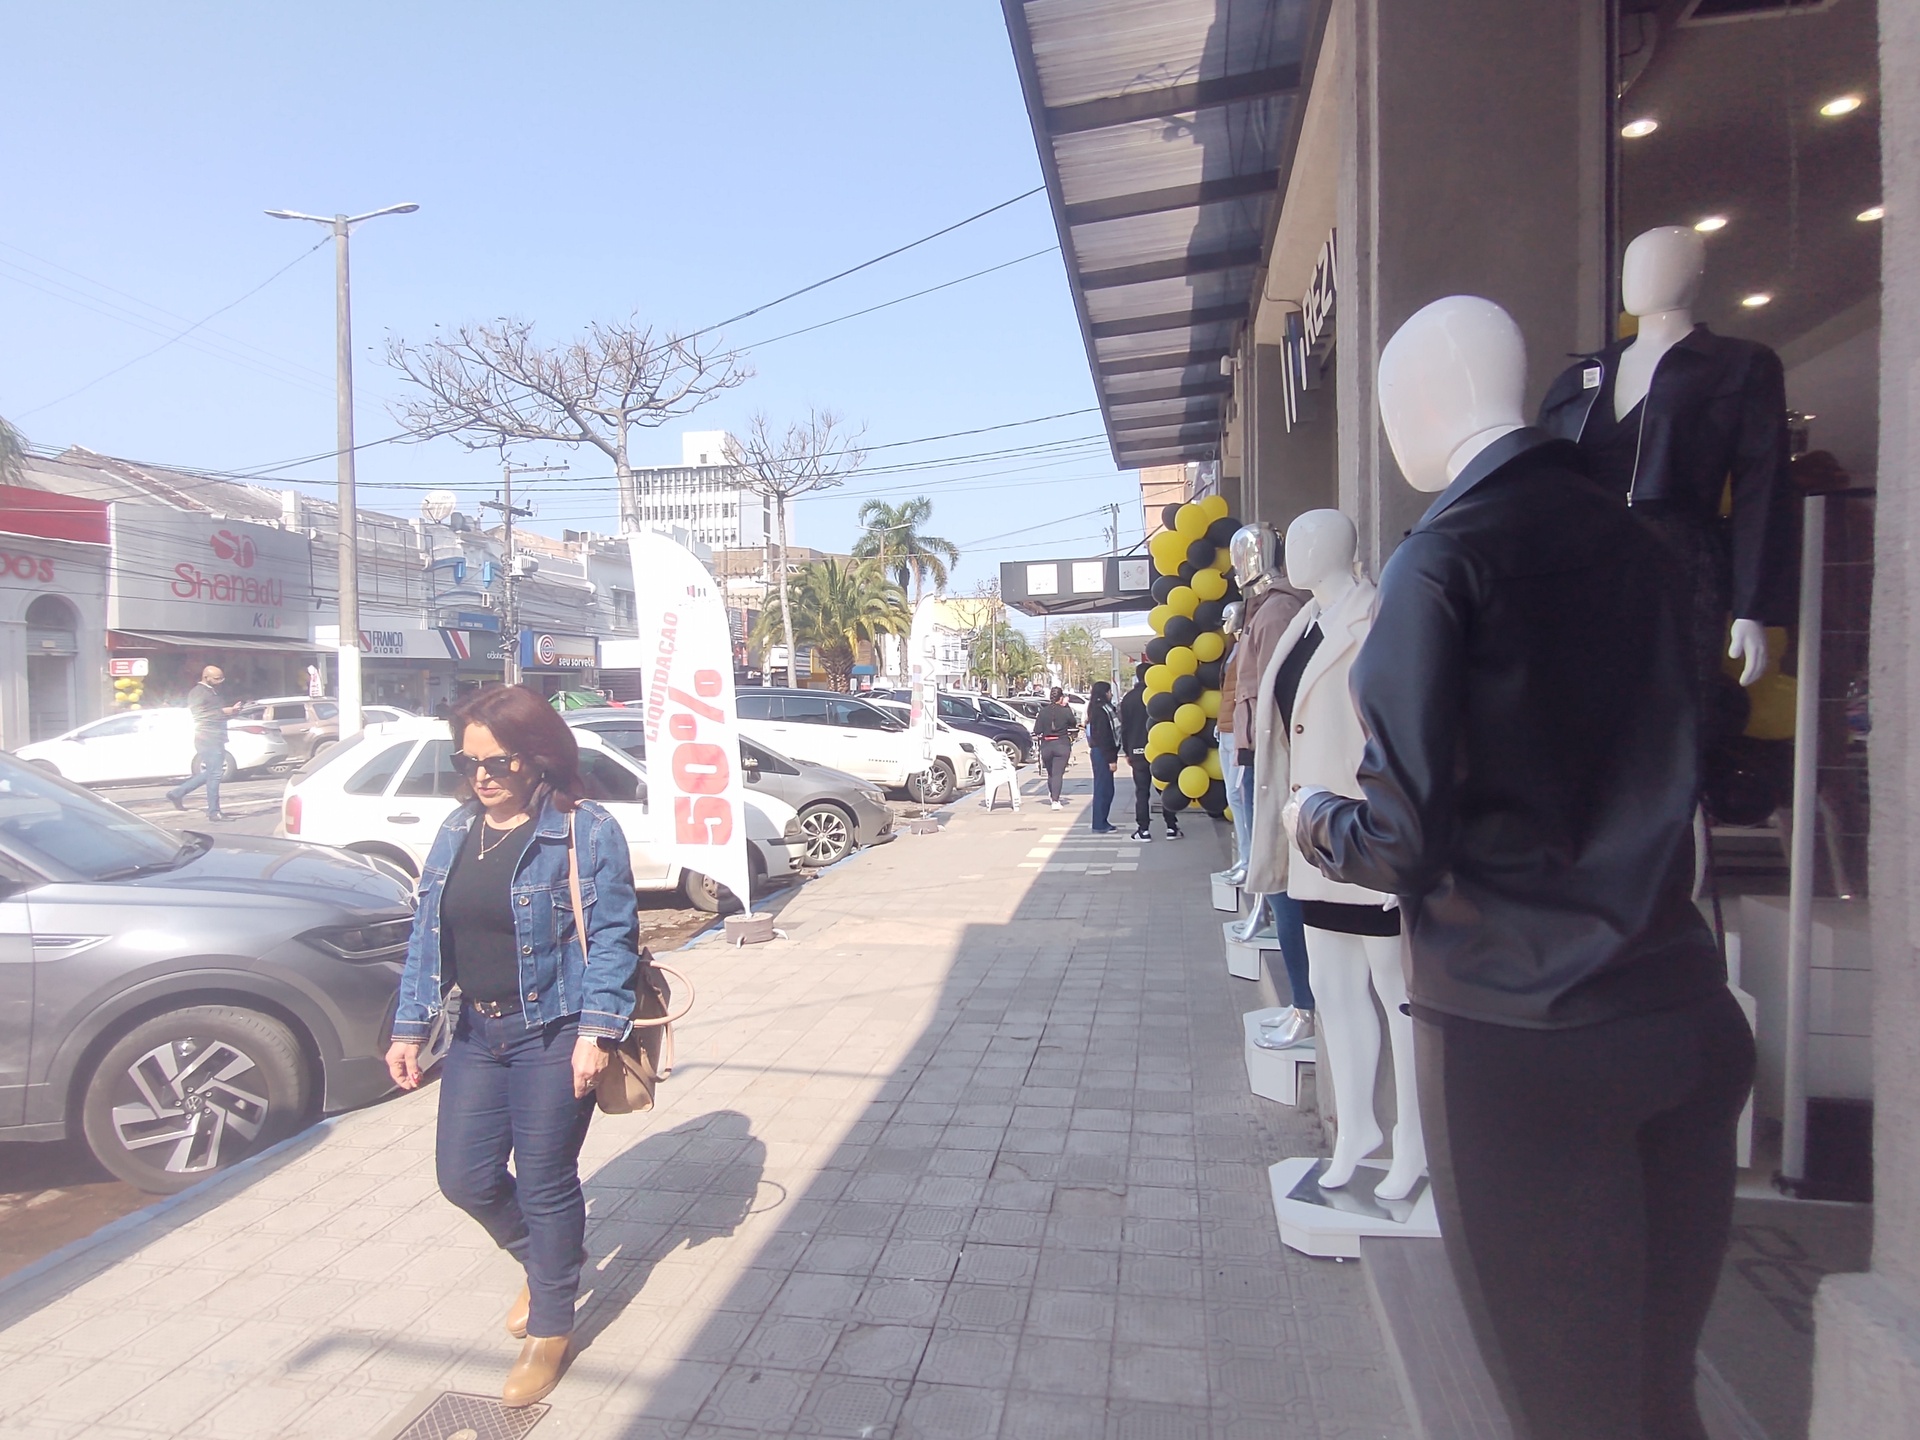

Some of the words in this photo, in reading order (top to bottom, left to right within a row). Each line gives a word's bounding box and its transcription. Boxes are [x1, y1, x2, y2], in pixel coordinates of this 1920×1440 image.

[252, 612, 282, 630] Kids
[373, 630, 404, 647] FRANCO
[373, 646, 404, 654] GIORGI
[558, 657, 571, 667] seu
[571, 656, 595, 668] sorvete
[668, 669, 733, 846] 50%
